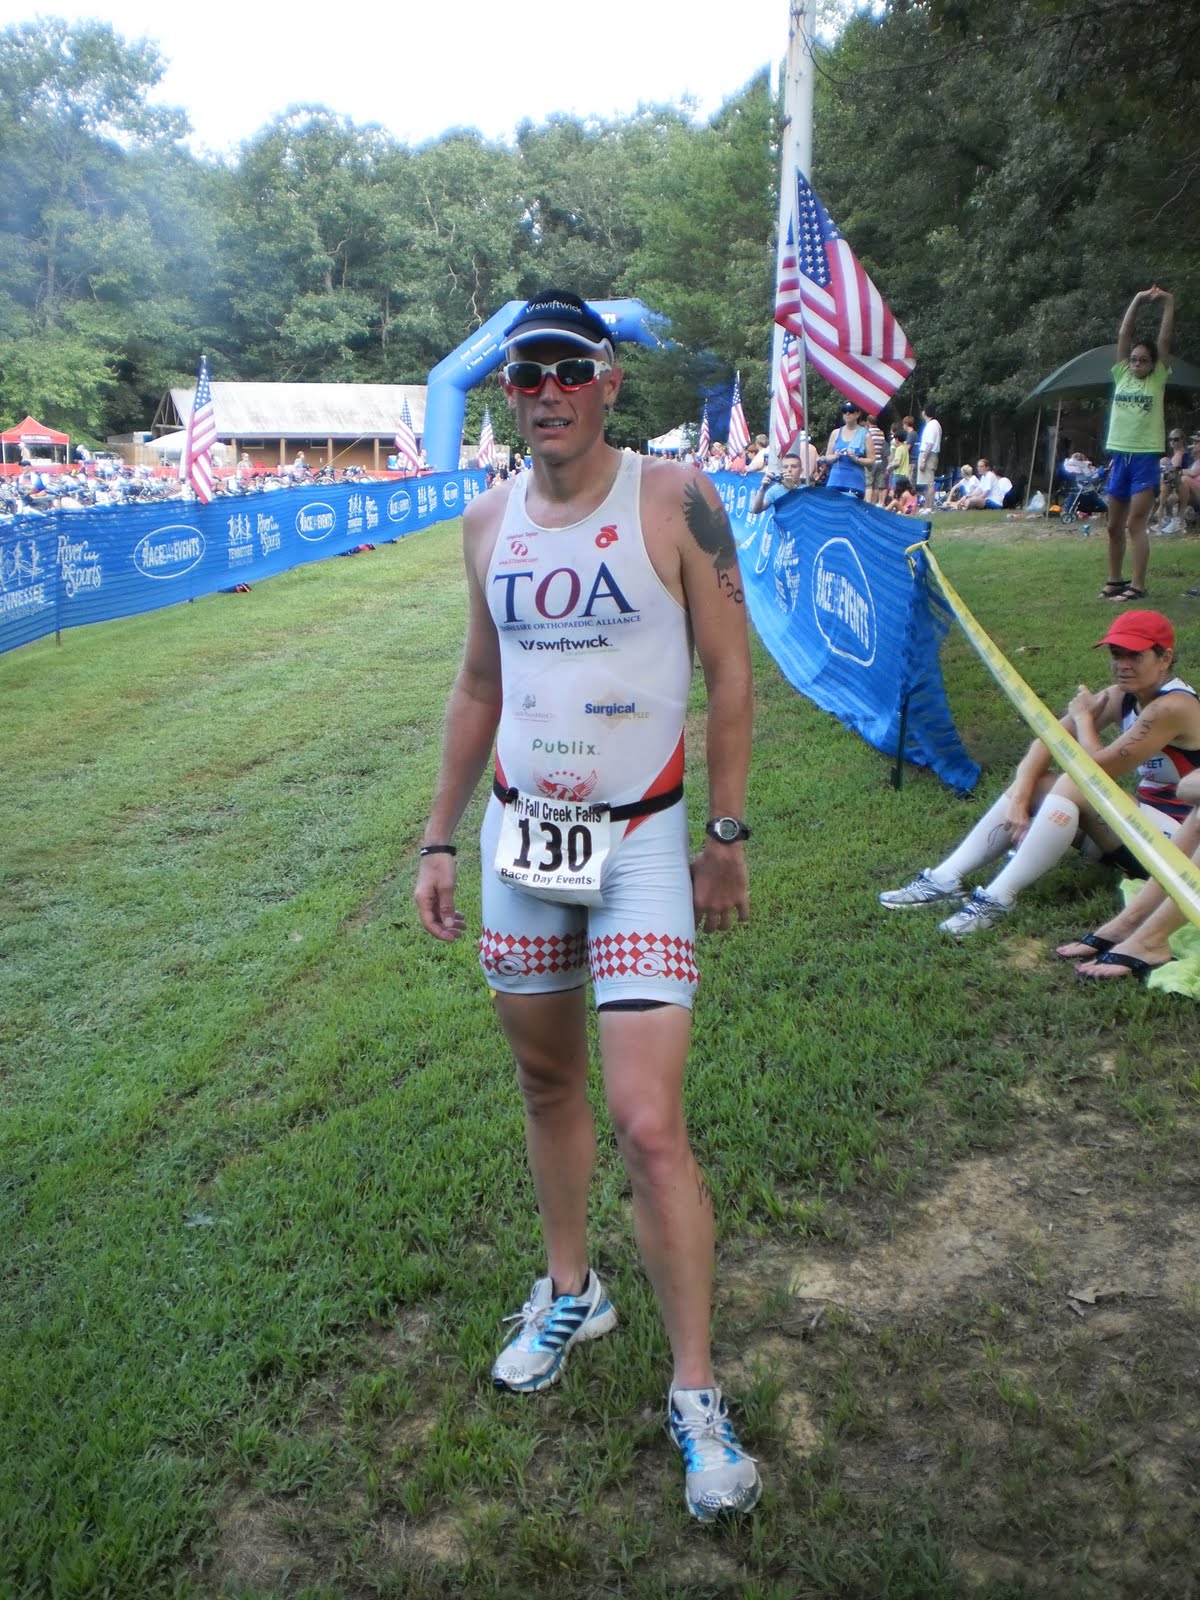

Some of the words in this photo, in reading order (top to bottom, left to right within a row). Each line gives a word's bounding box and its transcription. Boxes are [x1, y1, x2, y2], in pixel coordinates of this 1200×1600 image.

[535, 300, 582, 314] swiftwick
[56, 535, 89, 564] River
[142, 541, 165, 567] RACE
[173, 538, 199, 561] EVENTS
[62, 561, 102, 598] Sports
[493, 561, 640, 623] TOA
[717, 569, 743, 604] 130
[0, 583, 45, 613] ENNESSEE
[816, 555, 835, 613] RACE
[838, 575, 869, 650] EVENTS
[533, 620, 594, 631] ORTHOPAEDIC
[596, 615, 641, 627] ALLIANCE
[537, 635, 609, 652] swiftwick
[585, 702, 635, 716] Surgical
[532, 738, 596, 755] Publix
[514, 797, 524, 815] Tri
[525, 798, 540, 819] Fall
[542, 802, 572, 823] Creek
[575, 806, 602, 824] Falls
[513, 818, 592, 873] 130
[501, 868, 529, 881] Race
[532, 873, 553, 886] Day
[556, 874, 592, 886] Events
